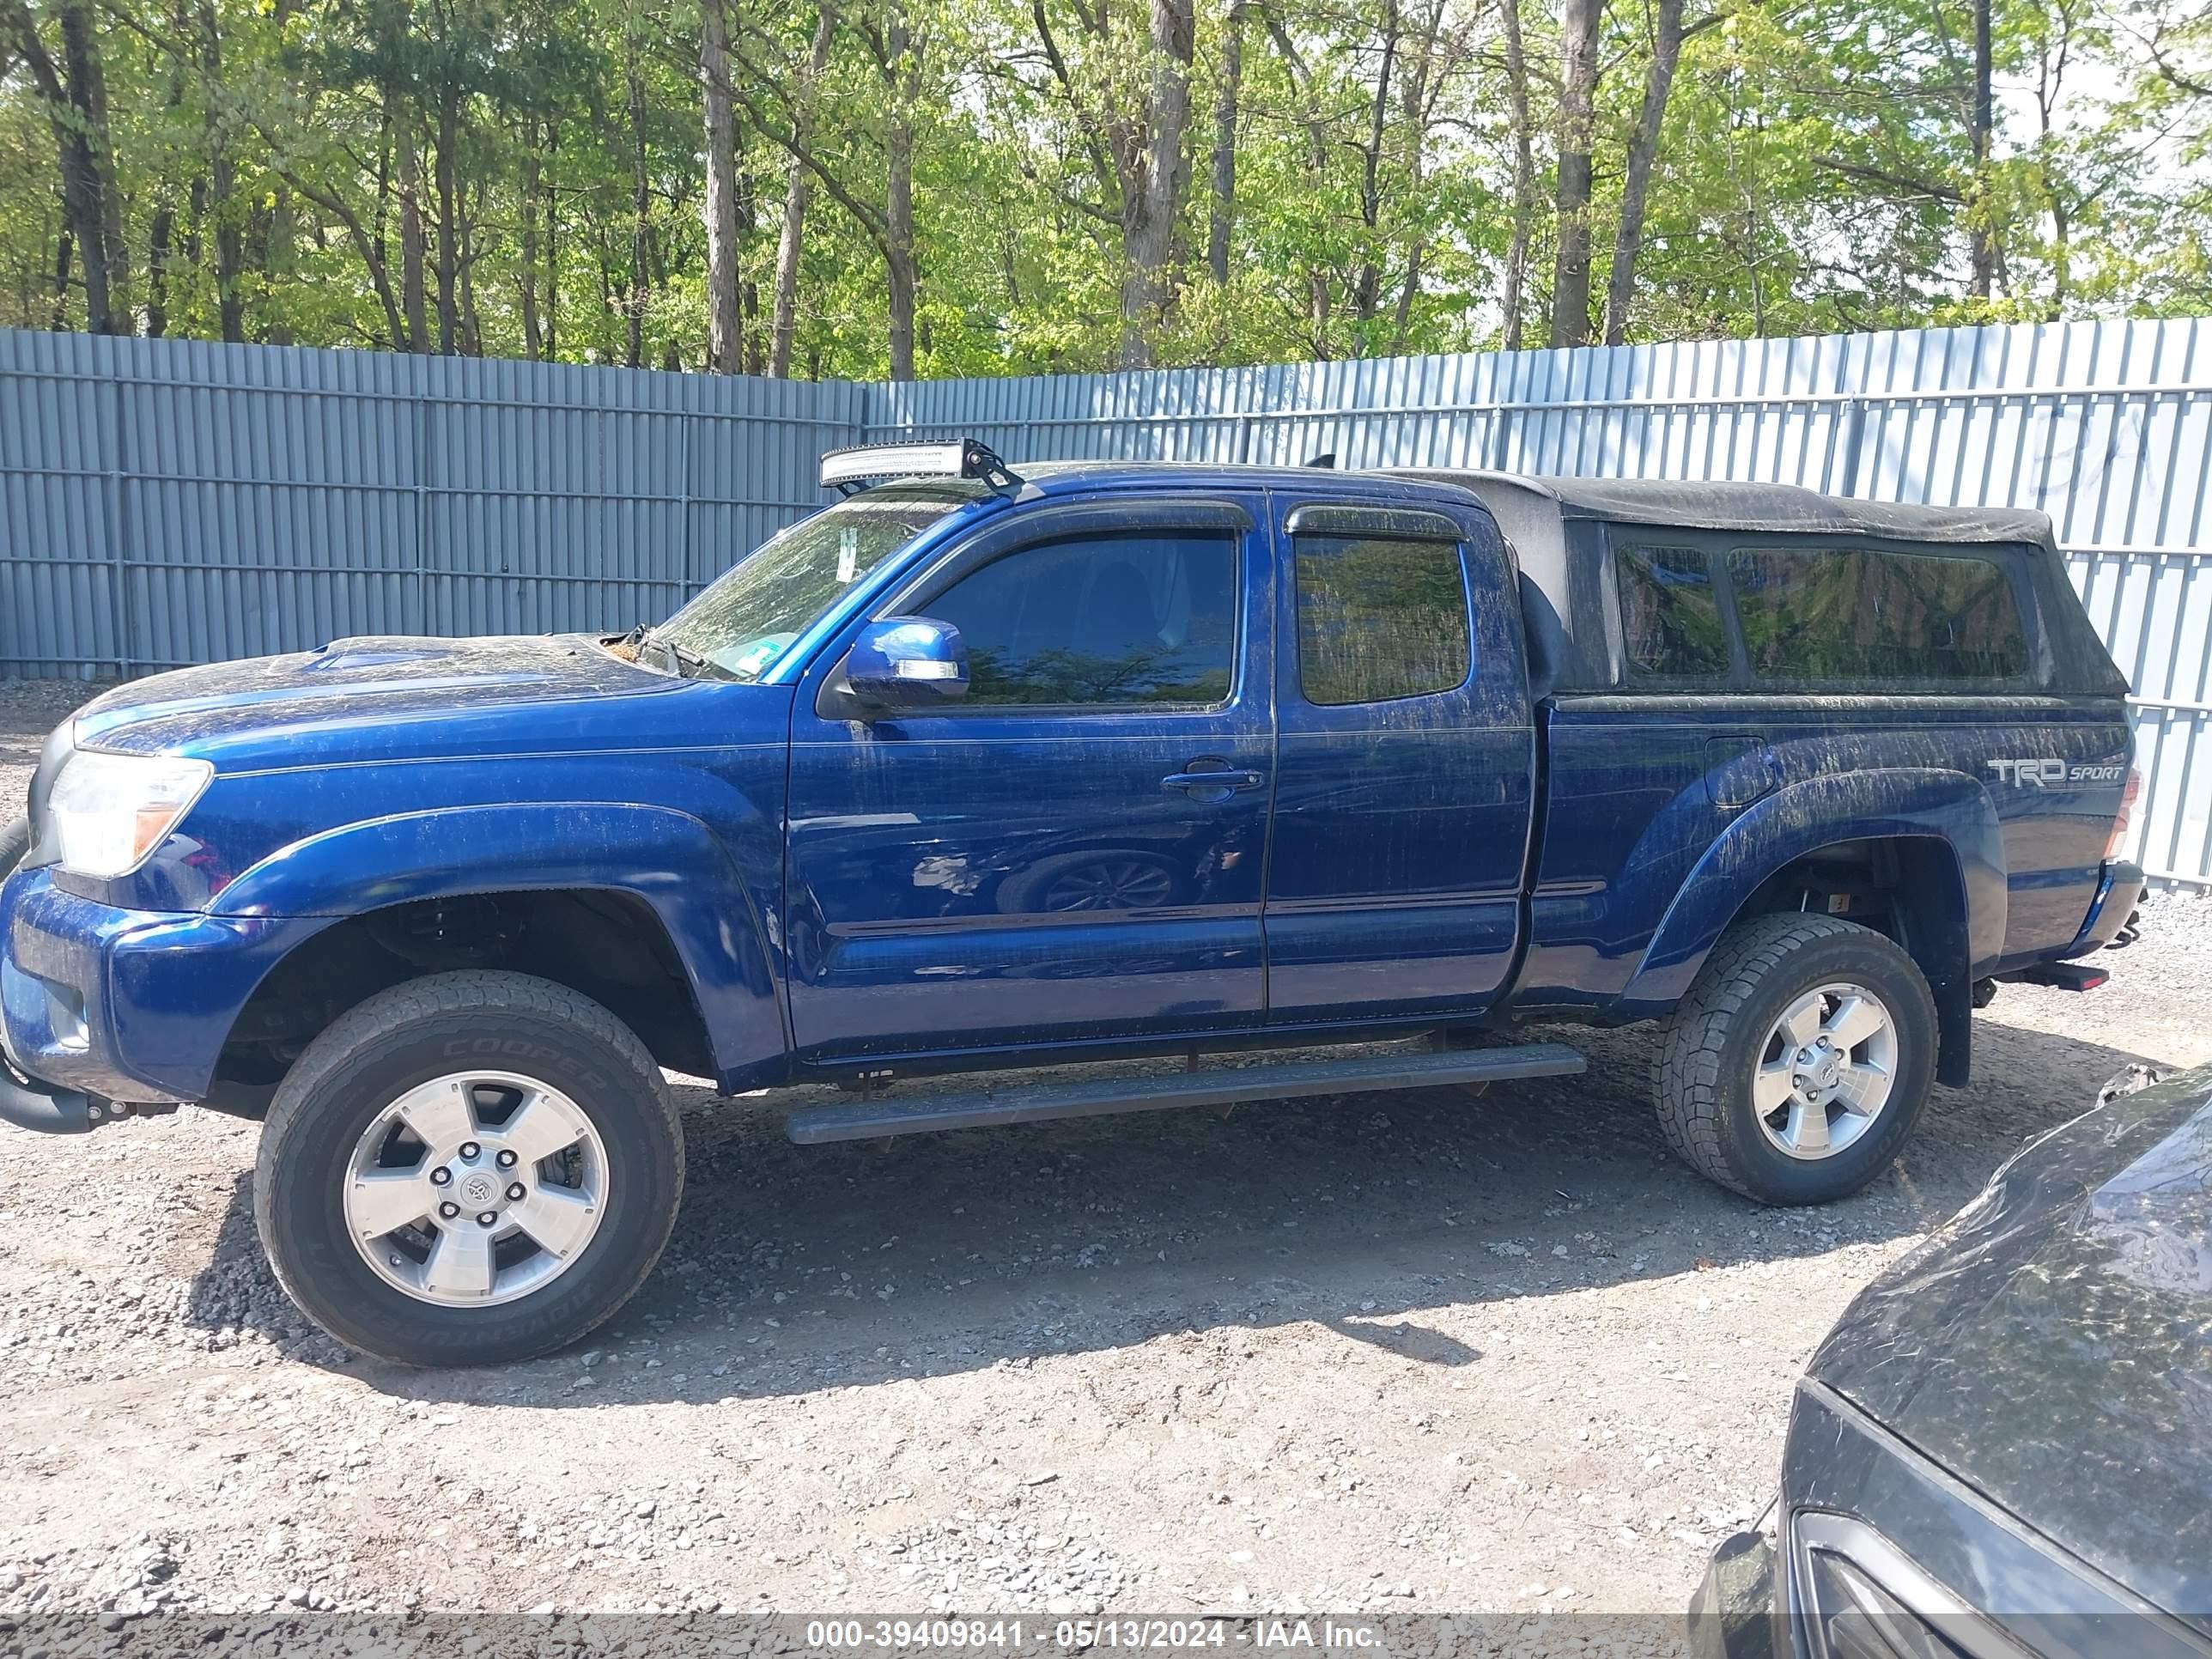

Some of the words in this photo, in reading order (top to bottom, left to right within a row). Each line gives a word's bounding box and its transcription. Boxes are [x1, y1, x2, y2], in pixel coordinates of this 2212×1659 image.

[1987, 759, 2066, 787] TRD
[2069, 767, 2124, 781] SPORT
[443, 1037, 607, 1091] COOPER
